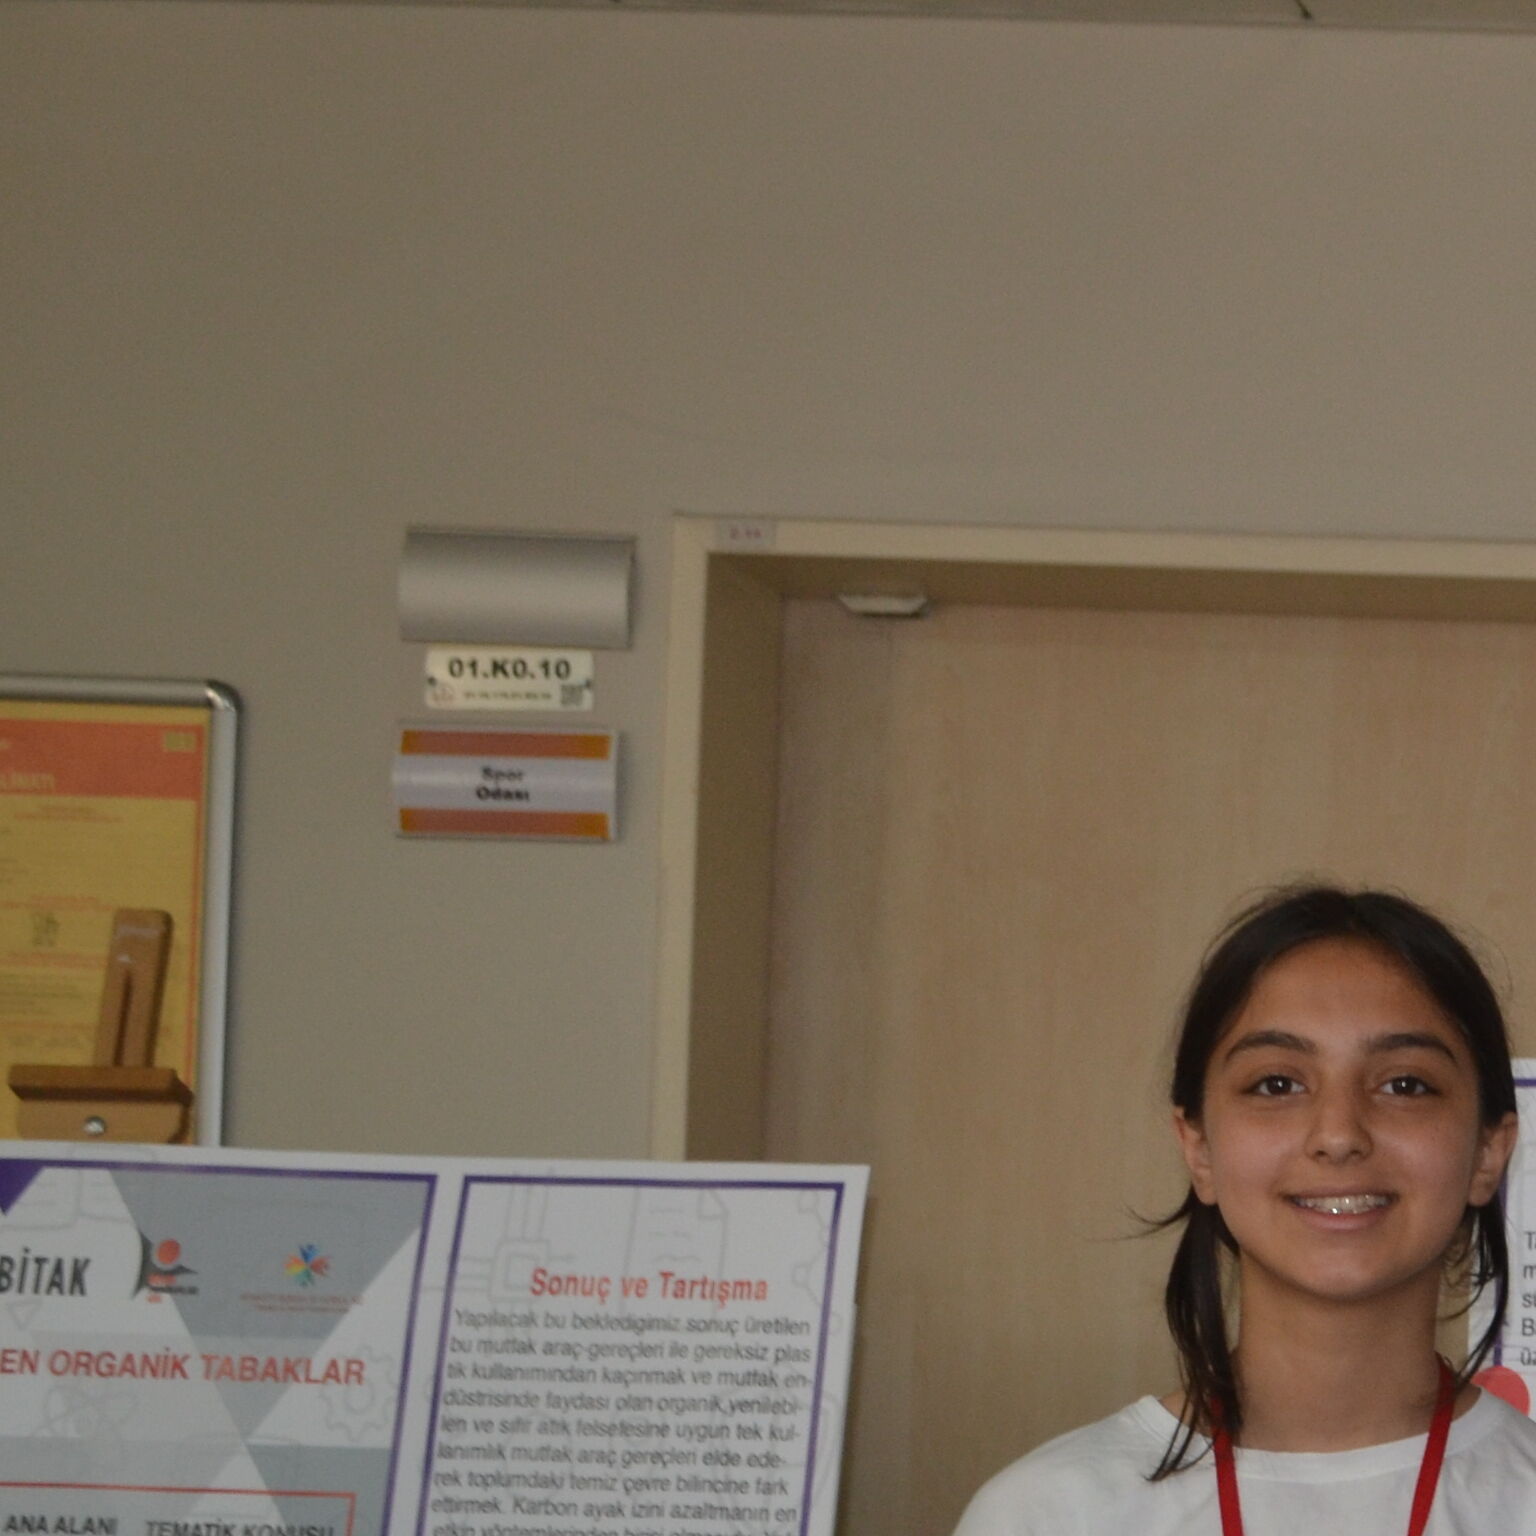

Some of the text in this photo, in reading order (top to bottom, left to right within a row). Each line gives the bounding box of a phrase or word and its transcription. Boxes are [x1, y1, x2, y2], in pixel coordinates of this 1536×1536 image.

[529, 1268, 768, 1309] Sonuç ve Tartışma
[48, 1347, 366, 1386] ORGANİK TABAKLAR
[5, 1515, 118, 1536] ANA ALANI
